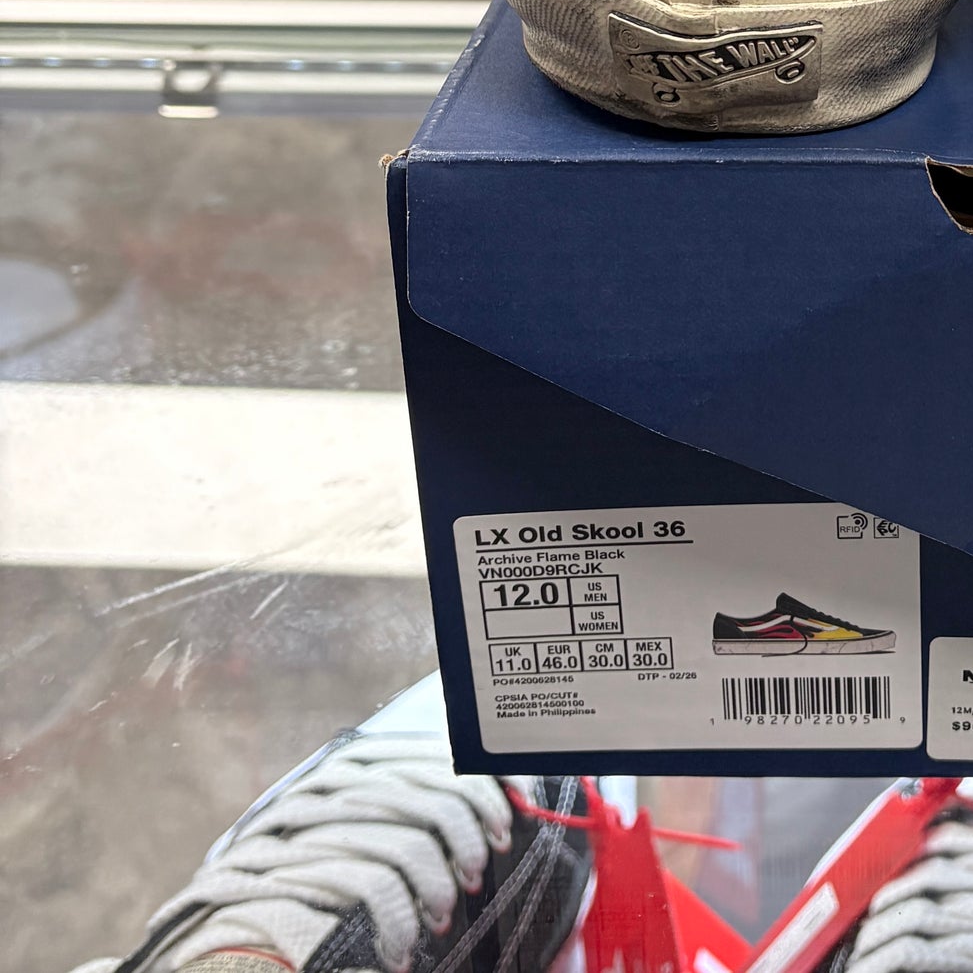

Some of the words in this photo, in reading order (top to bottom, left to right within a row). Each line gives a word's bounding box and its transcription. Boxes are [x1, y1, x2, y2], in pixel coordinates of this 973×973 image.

[656, 51, 735, 82] THE
[475, 527, 510, 546] LX
[518, 525, 563, 543] Old
[572, 521, 644, 541] Skool
[653, 520, 686, 538] 36
[839, 525, 861, 533] RFID
[478, 553, 532, 566] Archive
[536, 551, 580, 563] Flame
[585, 548, 625, 561] Black
[478, 562, 603, 579] VN000D9RCJK
[587, 582, 602, 591] US
[493, 582, 559, 607] 12.0
[584, 593, 608, 602] MEN
[590, 611, 605, 620] US
[578, 621, 619, 631] WOMEN
[547, 645, 571, 655] EUR
[595, 643, 614, 653] CM
[635, 641, 662, 652] MEX
[505, 647, 522, 657] UK
[495, 658, 532, 672] 11.0
[542, 656, 578, 670] 46.0
[588, 654, 624, 668] 30.0
[632, 653, 668, 667] 30.0
[637, 673, 659, 681] DTP
[494, 694, 528, 702] CPSIA
[497, 710, 526, 718] Made
[528, 709, 538, 717] in
[540, 709, 596, 717] Philippines
